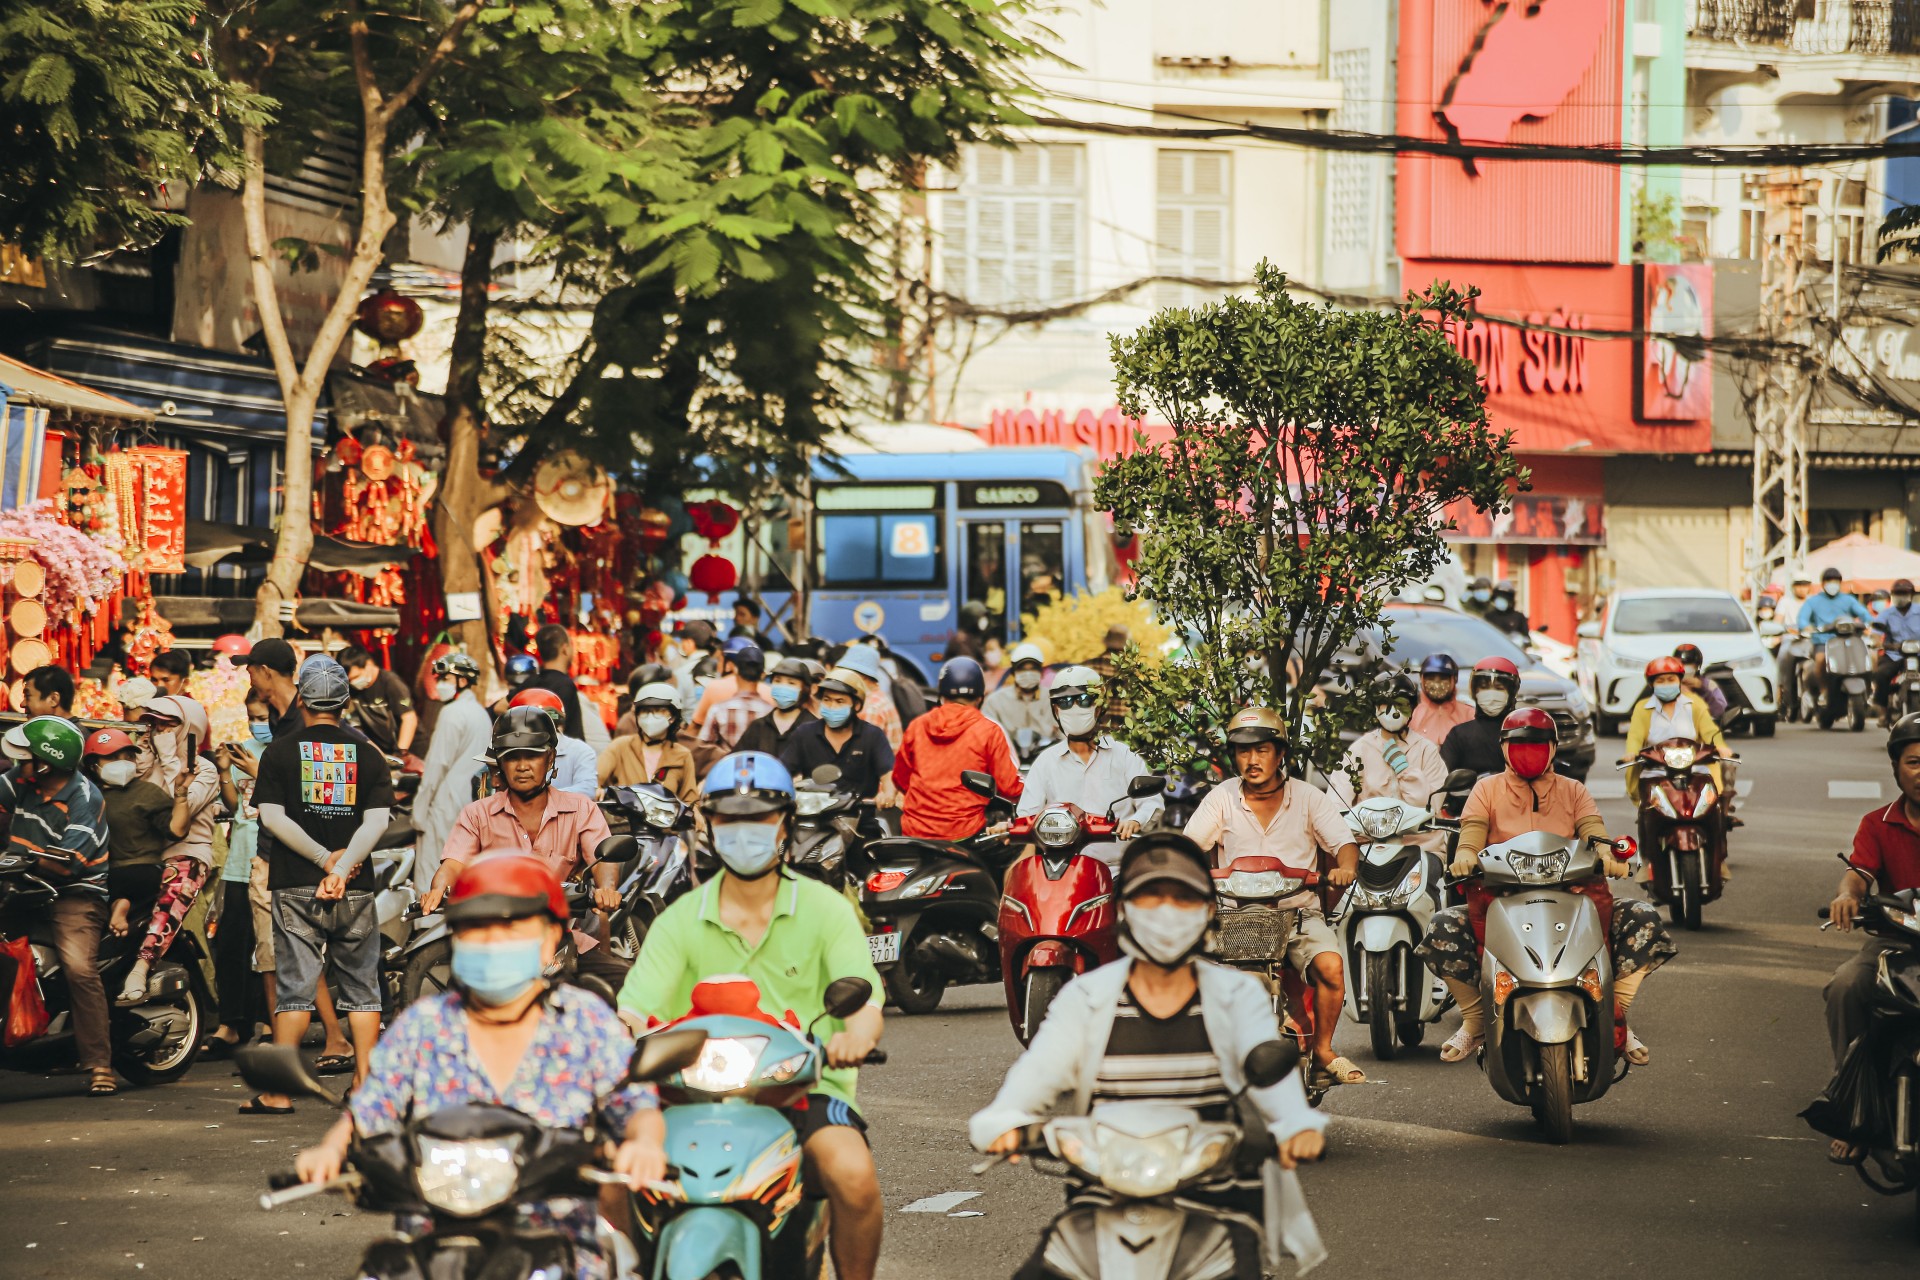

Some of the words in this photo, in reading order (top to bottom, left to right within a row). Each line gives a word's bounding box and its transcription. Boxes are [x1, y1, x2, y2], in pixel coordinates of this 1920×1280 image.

[898, 526, 922, 553] 8
[40, 742, 65, 760] Grab
[869, 934, 895, 949] 59-M2
